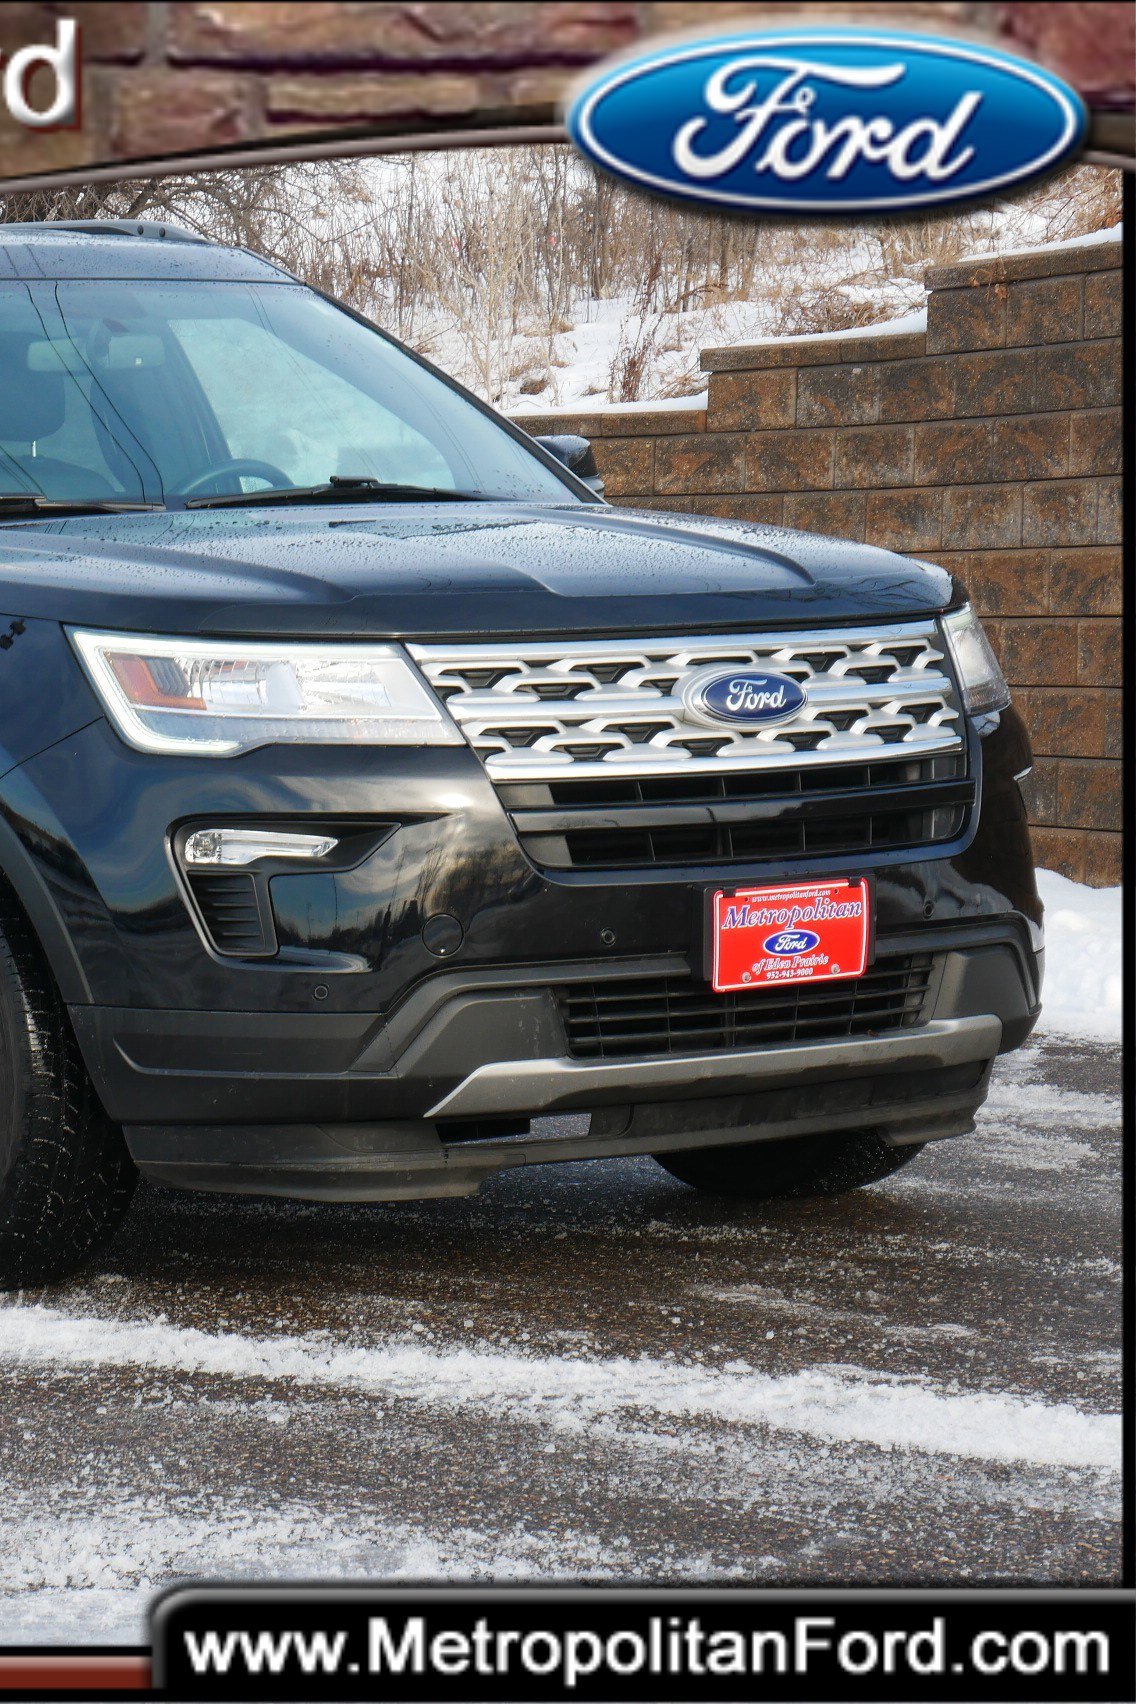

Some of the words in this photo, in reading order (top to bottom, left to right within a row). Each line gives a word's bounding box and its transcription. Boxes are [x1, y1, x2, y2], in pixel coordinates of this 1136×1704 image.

[726, 679, 786, 711] Ford
[752, 890, 831, 903] www.metropolitanford.com
[722, 898, 862, 930] Metropolitan
[775, 934, 808, 951] Ford
[752, 958, 766, 976] of
[764, 957, 791, 971] Eden
[791, 952, 830, 969] Prairie
